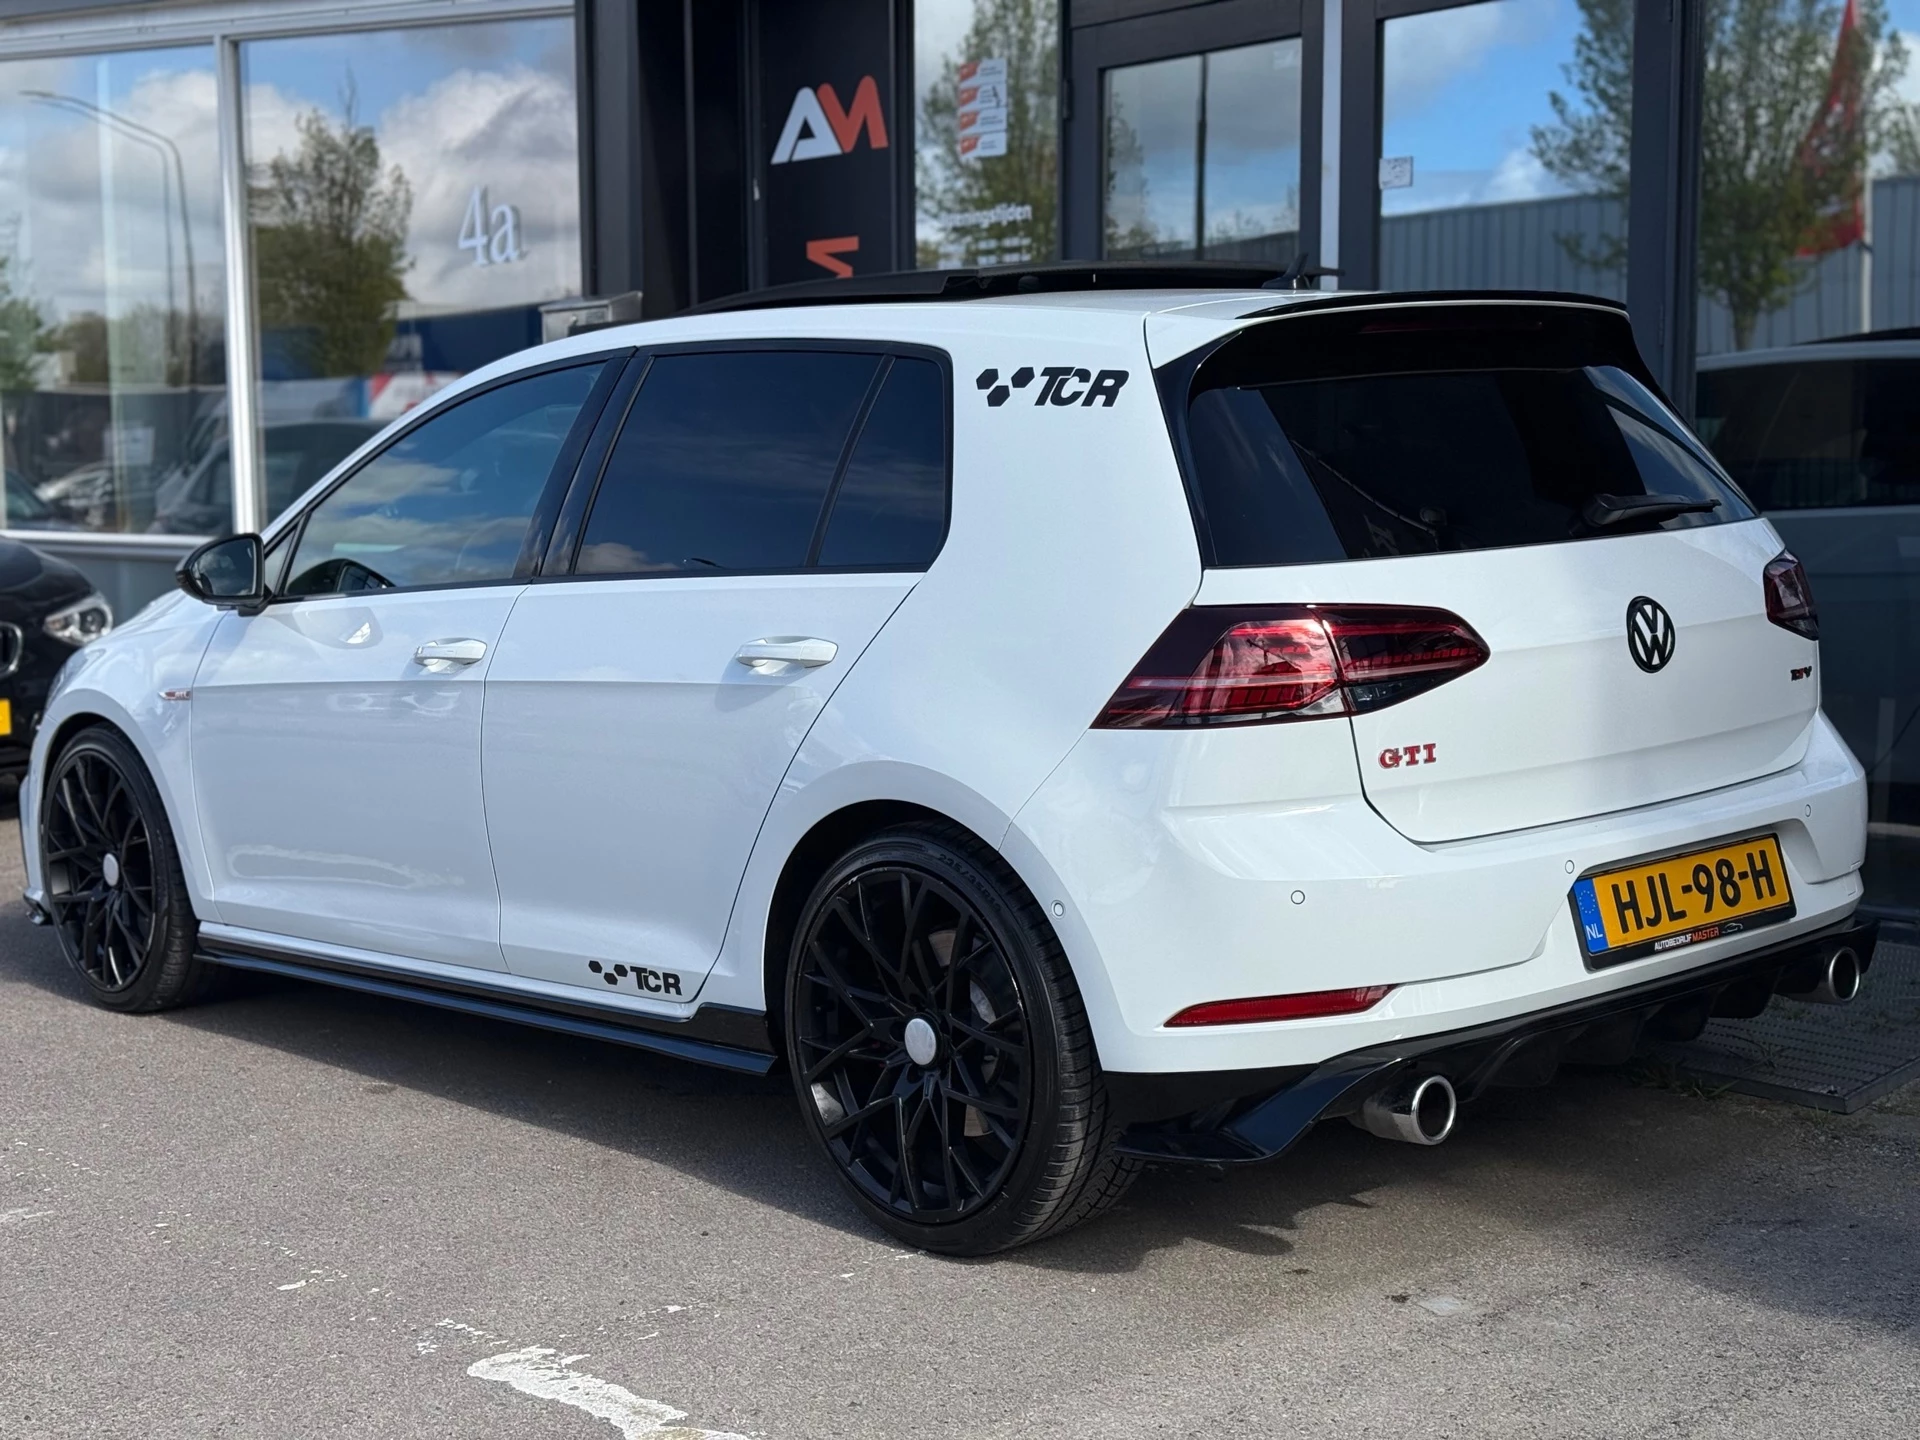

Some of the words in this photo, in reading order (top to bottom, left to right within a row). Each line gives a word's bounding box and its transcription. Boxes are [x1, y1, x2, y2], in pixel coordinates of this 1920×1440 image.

[770, 75, 889, 165] AM
[458, 185, 520, 266] 4a
[1034, 366, 1130, 408] TCR
[1378, 743, 1437, 769] GTI
[1611, 849, 1777, 935] HJL-98-H
[1585, 923, 1604, 941] NL
[630, 965, 683, 996] TCR
